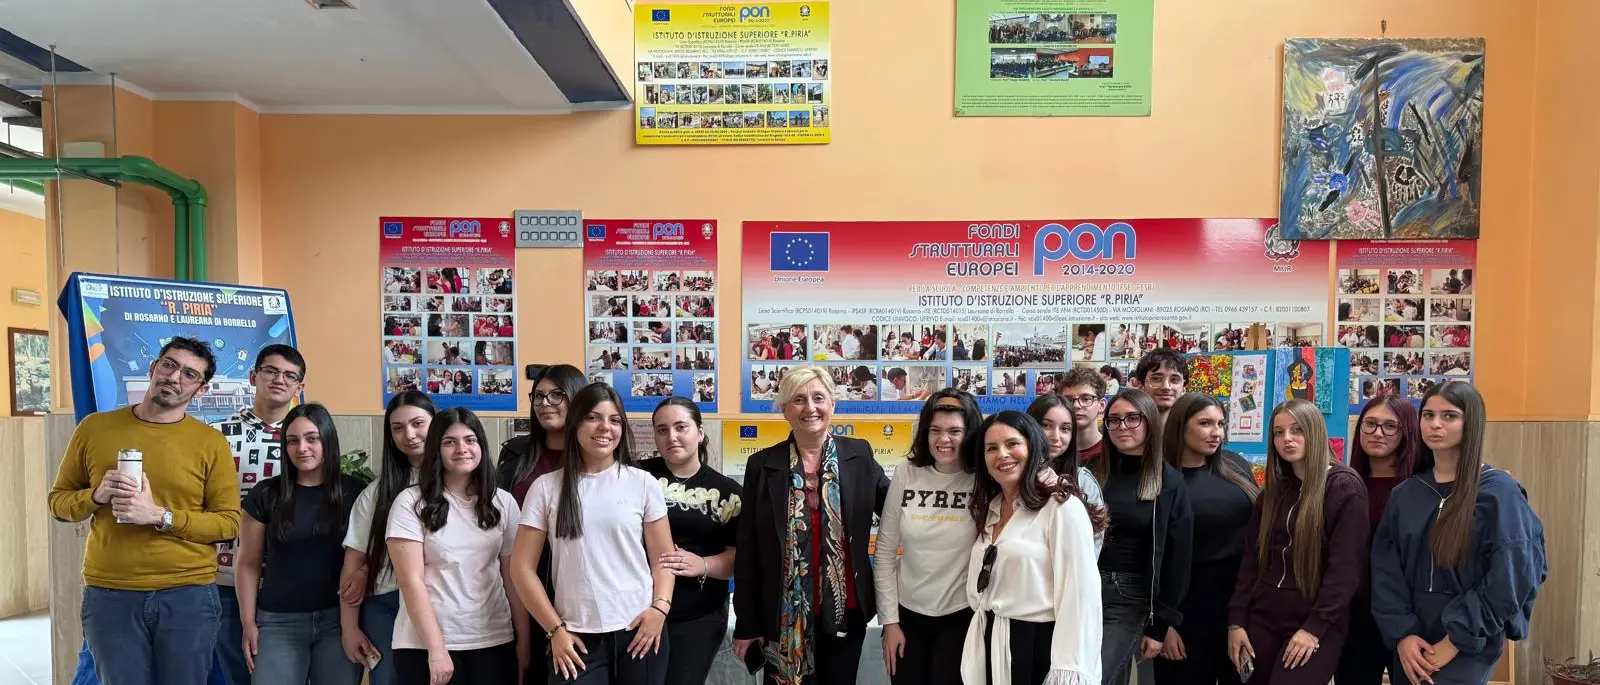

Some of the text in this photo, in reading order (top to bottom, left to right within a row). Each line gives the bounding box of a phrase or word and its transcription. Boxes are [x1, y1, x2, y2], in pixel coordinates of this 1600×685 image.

[740, 6, 770, 22] pon
[688, 32, 737, 40] D'ISTRUZIONE
[450, 220, 480, 238] pon
[653, 223, 684, 240] pon
[968, 224, 1020, 239] FONDI
[909, 243, 1020, 257] STRUTTURALI
[1033, 222, 1136, 276] pon
[946, 261, 1020, 276] EUROPEI
[1062, 264, 1135, 276] 2014-2020
[110, 286, 151, 299] ISTITUTO
[154, 288, 215, 304] D'ISTRUZIONE
[217, 293, 263, 307] SUPERIORE
[919, 295, 963, 306] ISTITUTO
[967, 295, 1038, 306] D'ISTRUZIONE
[1042, 294, 1096, 306] SUPERIORE
[125, 312, 132, 321] DI
[134, 313, 169, 324] ROSARNO
[176, 315, 213, 326] LAUREANA
[214, 318, 222, 326] DI
[223, 318, 257, 329] BORRELLO
